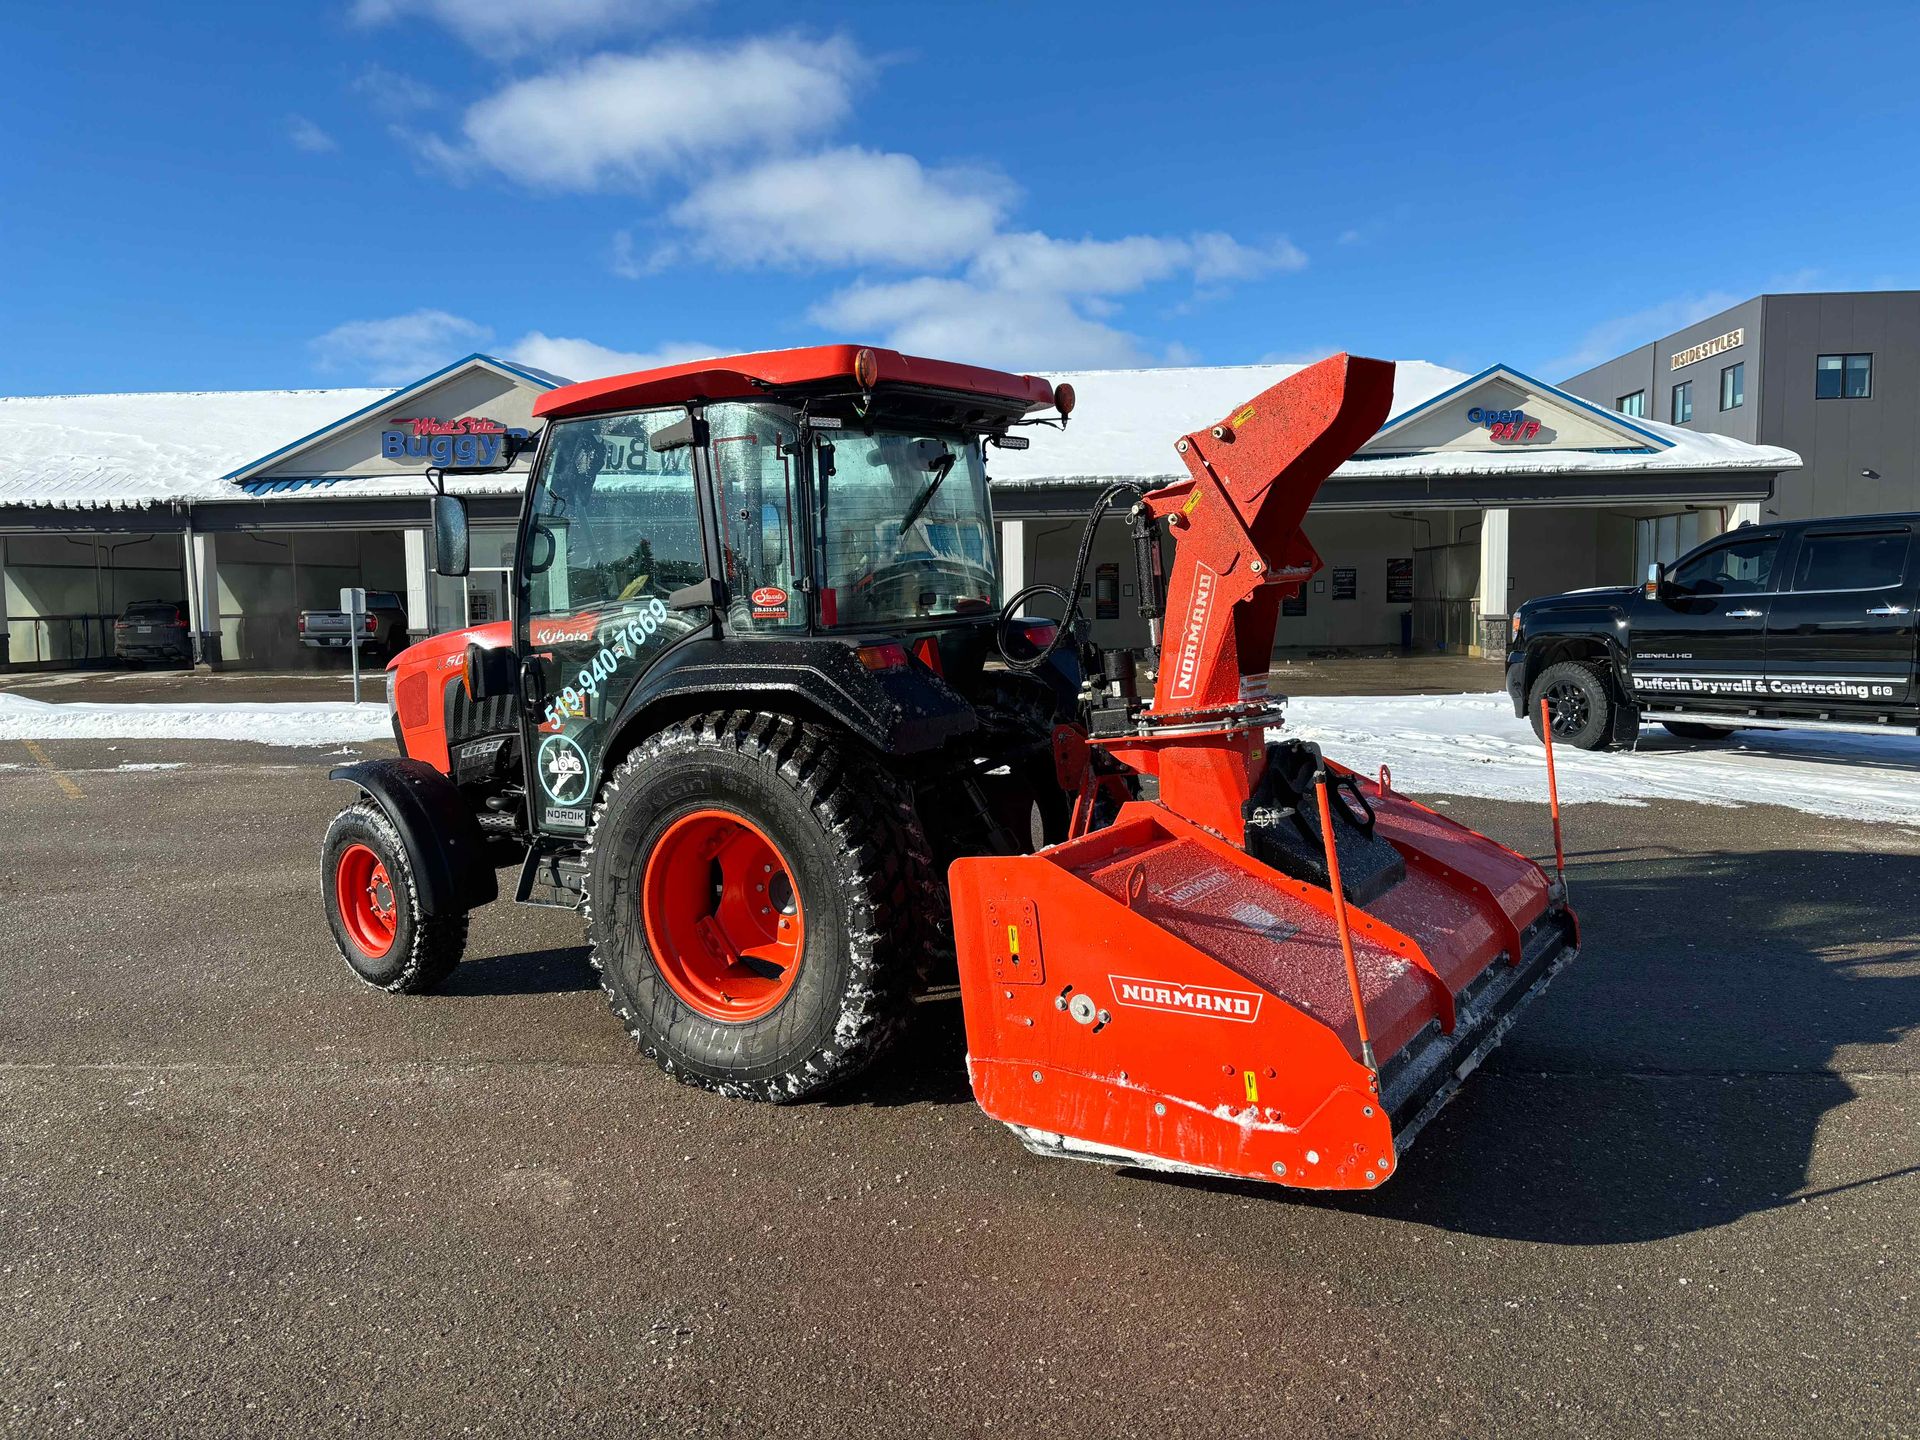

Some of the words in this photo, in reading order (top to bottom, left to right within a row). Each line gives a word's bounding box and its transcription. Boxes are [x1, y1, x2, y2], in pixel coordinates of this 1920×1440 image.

[406, 417, 456, 435] West
[454, 416, 504, 435] Side
[1467, 407, 1524, 429] Open
[1490, 420, 1541, 441] 24/7
[382, 431, 501, 467] Buggy
[537, 628, 588, 644] Kubota
[1178, 574, 1211, 690] NORMAND
[544, 597, 668, 730] 519-940-7669
[1633, 677, 1690, 691] Dufferin
[1691, 679, 1752, 694] Drywall
[1755, 681, 1769, 693] &
[1770, 680, 1869, 699] Contracting
[547, 810, 584, 821] NORDIK
[1122, 984, 1250, 1015] NORMAND
